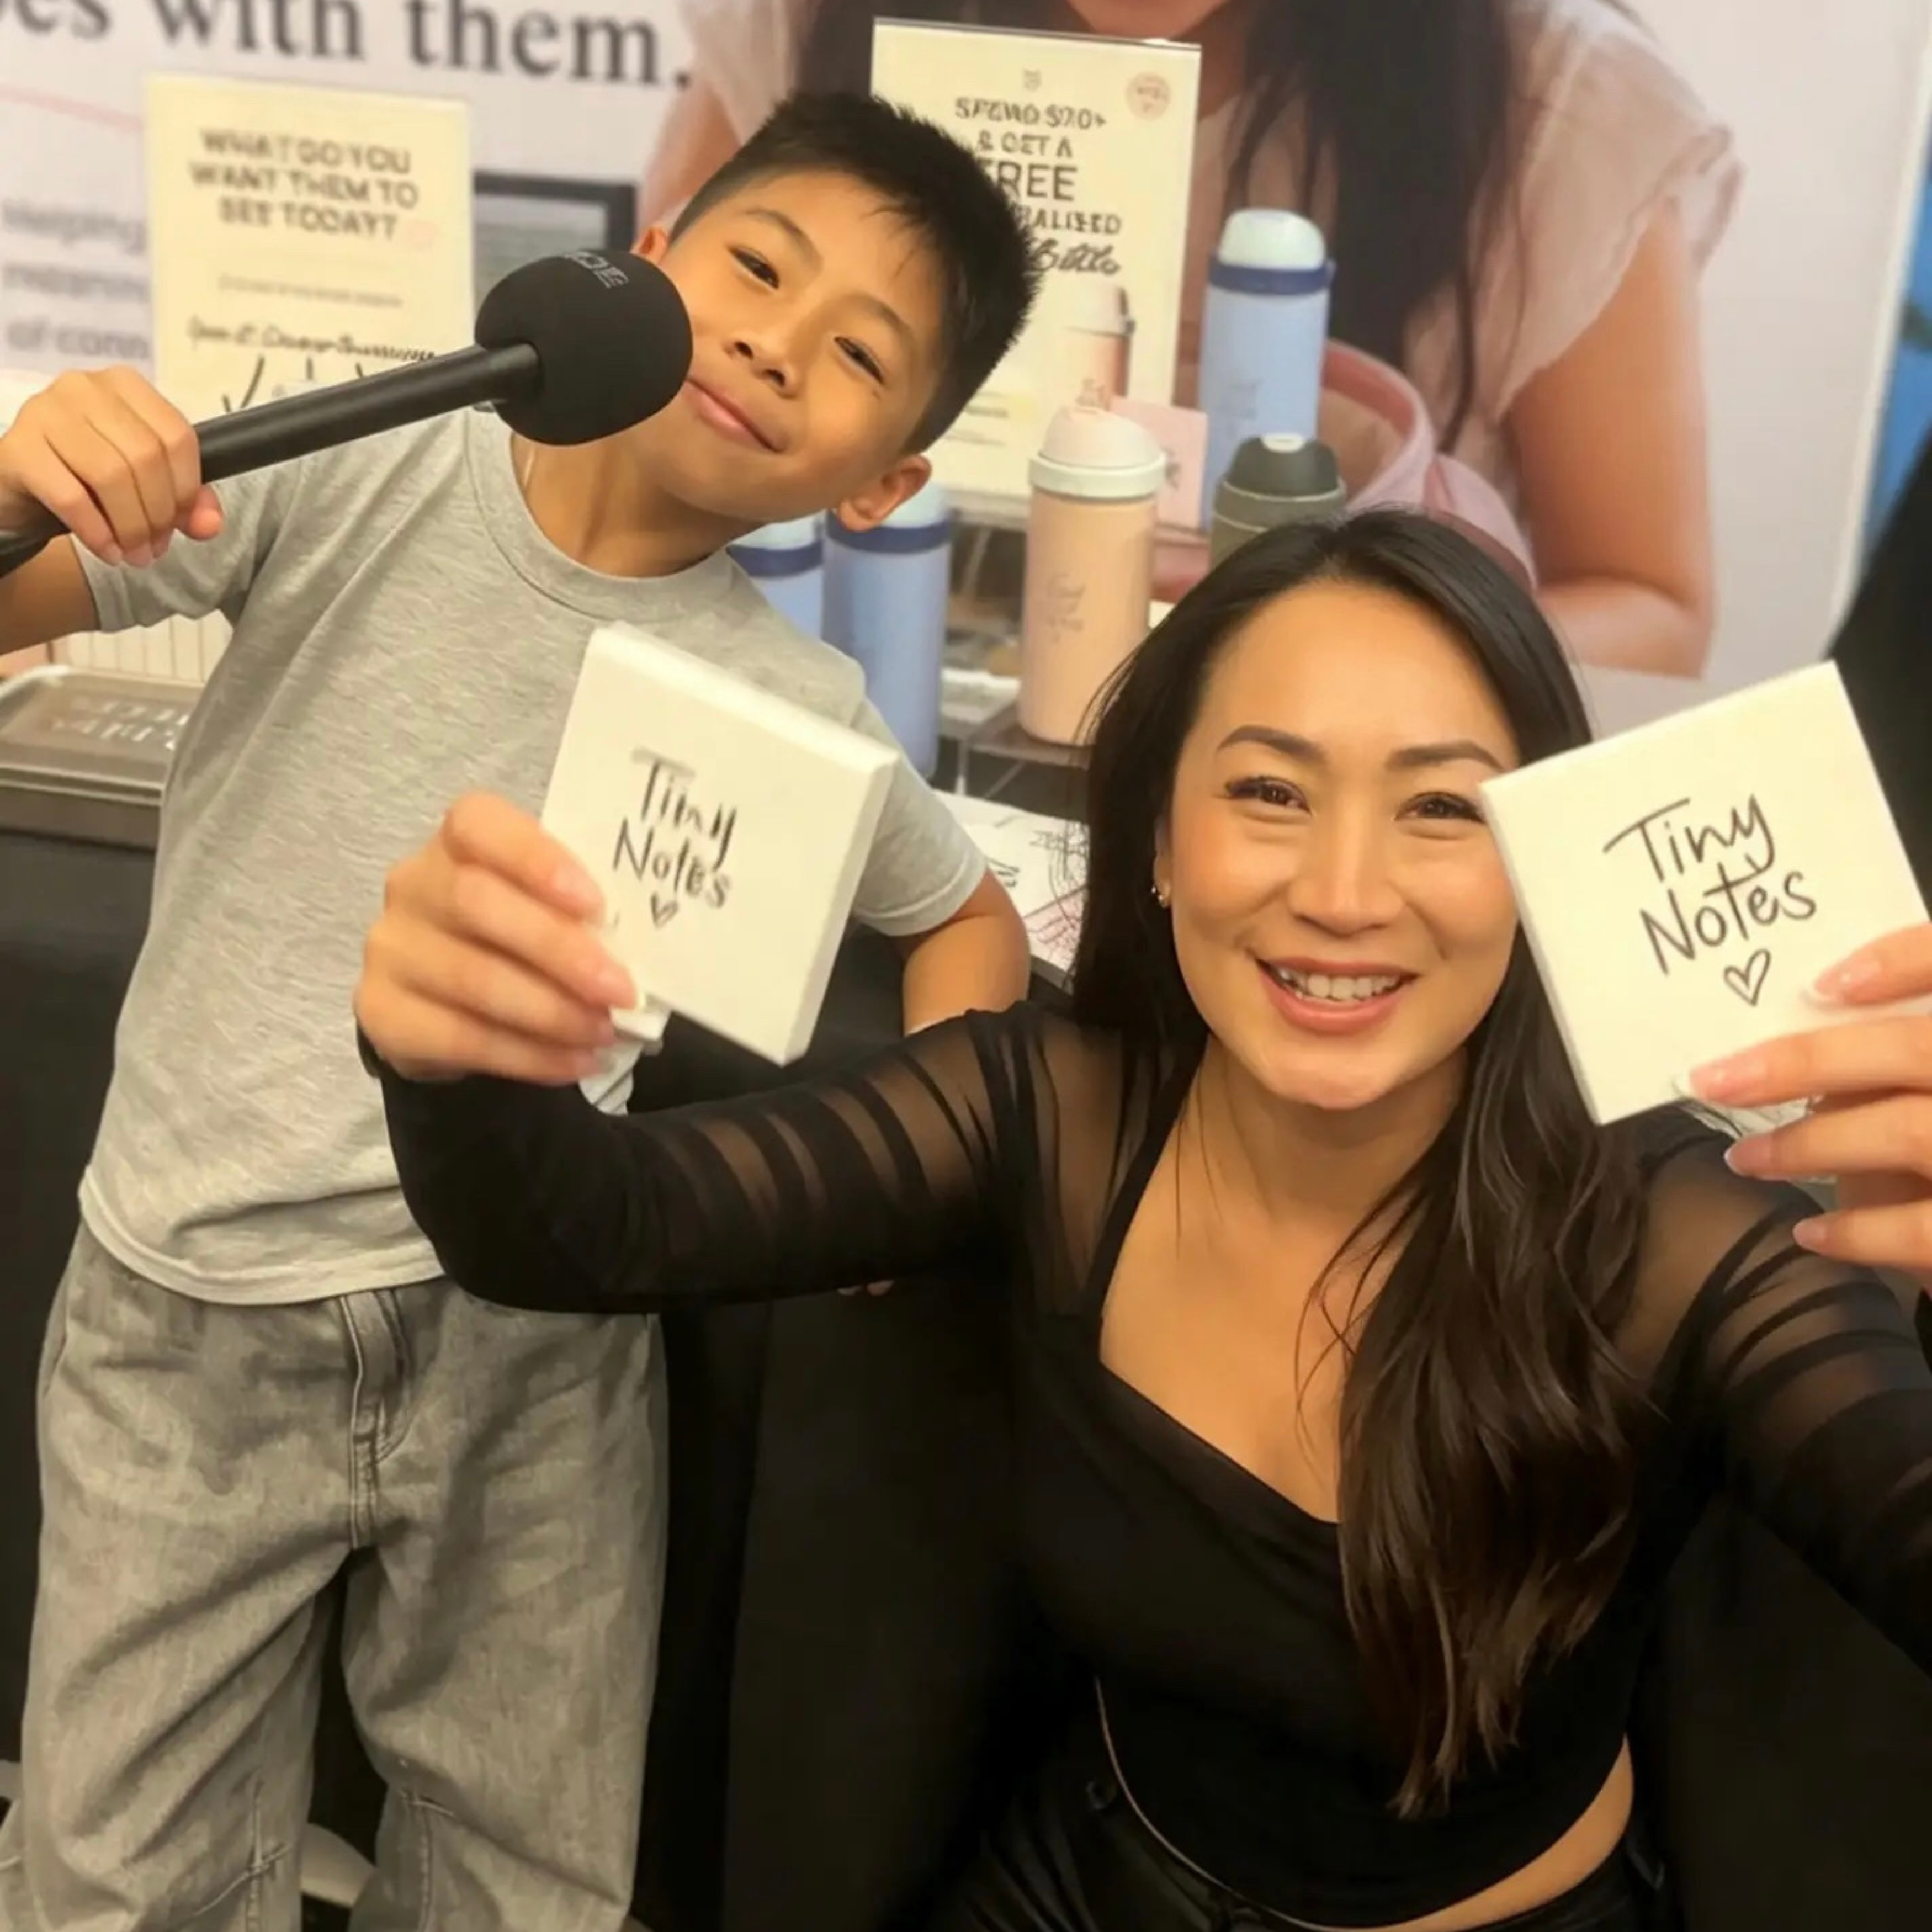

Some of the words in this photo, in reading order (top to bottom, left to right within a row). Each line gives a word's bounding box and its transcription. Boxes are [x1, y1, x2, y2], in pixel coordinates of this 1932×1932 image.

[0, 0, 112, 41] es
[146, 0, 364, 62] with
[406, 0, 692, 90] them.
[189, 162, 277, 194] WANT
[286, 167, 372, 204] THEM
[375, 177, 420, 210] TO
[349, 143, 411, 174] YOU
[1001, 131, 1051, 157] GET
[1056, 136, 1074, 160] A
[631, 745, 737, 873] Tiny
[1601, 793, 1775, 882] Tiny
[612, 818, 732, 909] Notes
[1639, 862, 1817, 976] Notes
